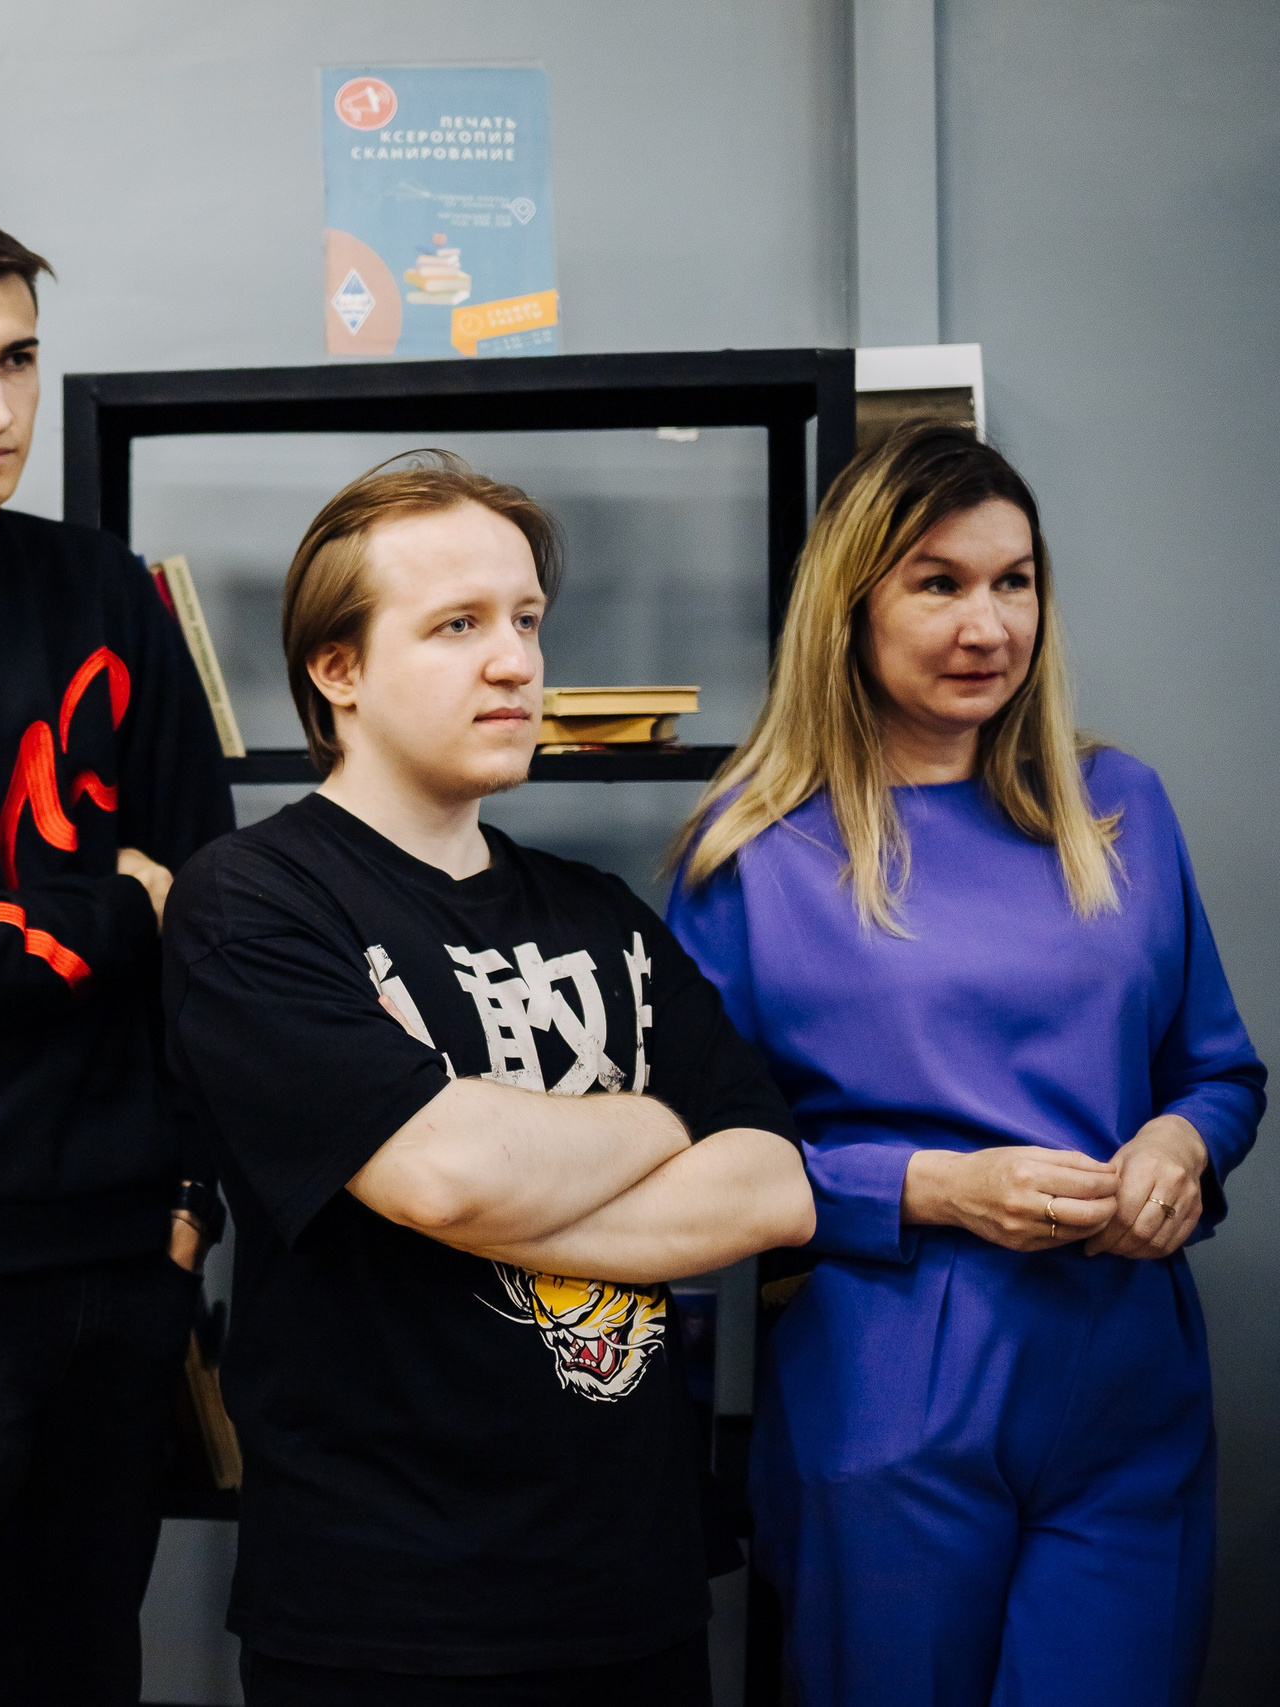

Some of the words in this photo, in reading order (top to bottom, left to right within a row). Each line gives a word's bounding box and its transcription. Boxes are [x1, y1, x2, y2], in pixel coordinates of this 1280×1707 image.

[440, 116, 517, 129] ПЕЧАТЬ
[380, 130, 515, 144] КСЕРОКОПИЯ
[350, 146, 515, 161] СКАНИРОВАНИЕ
